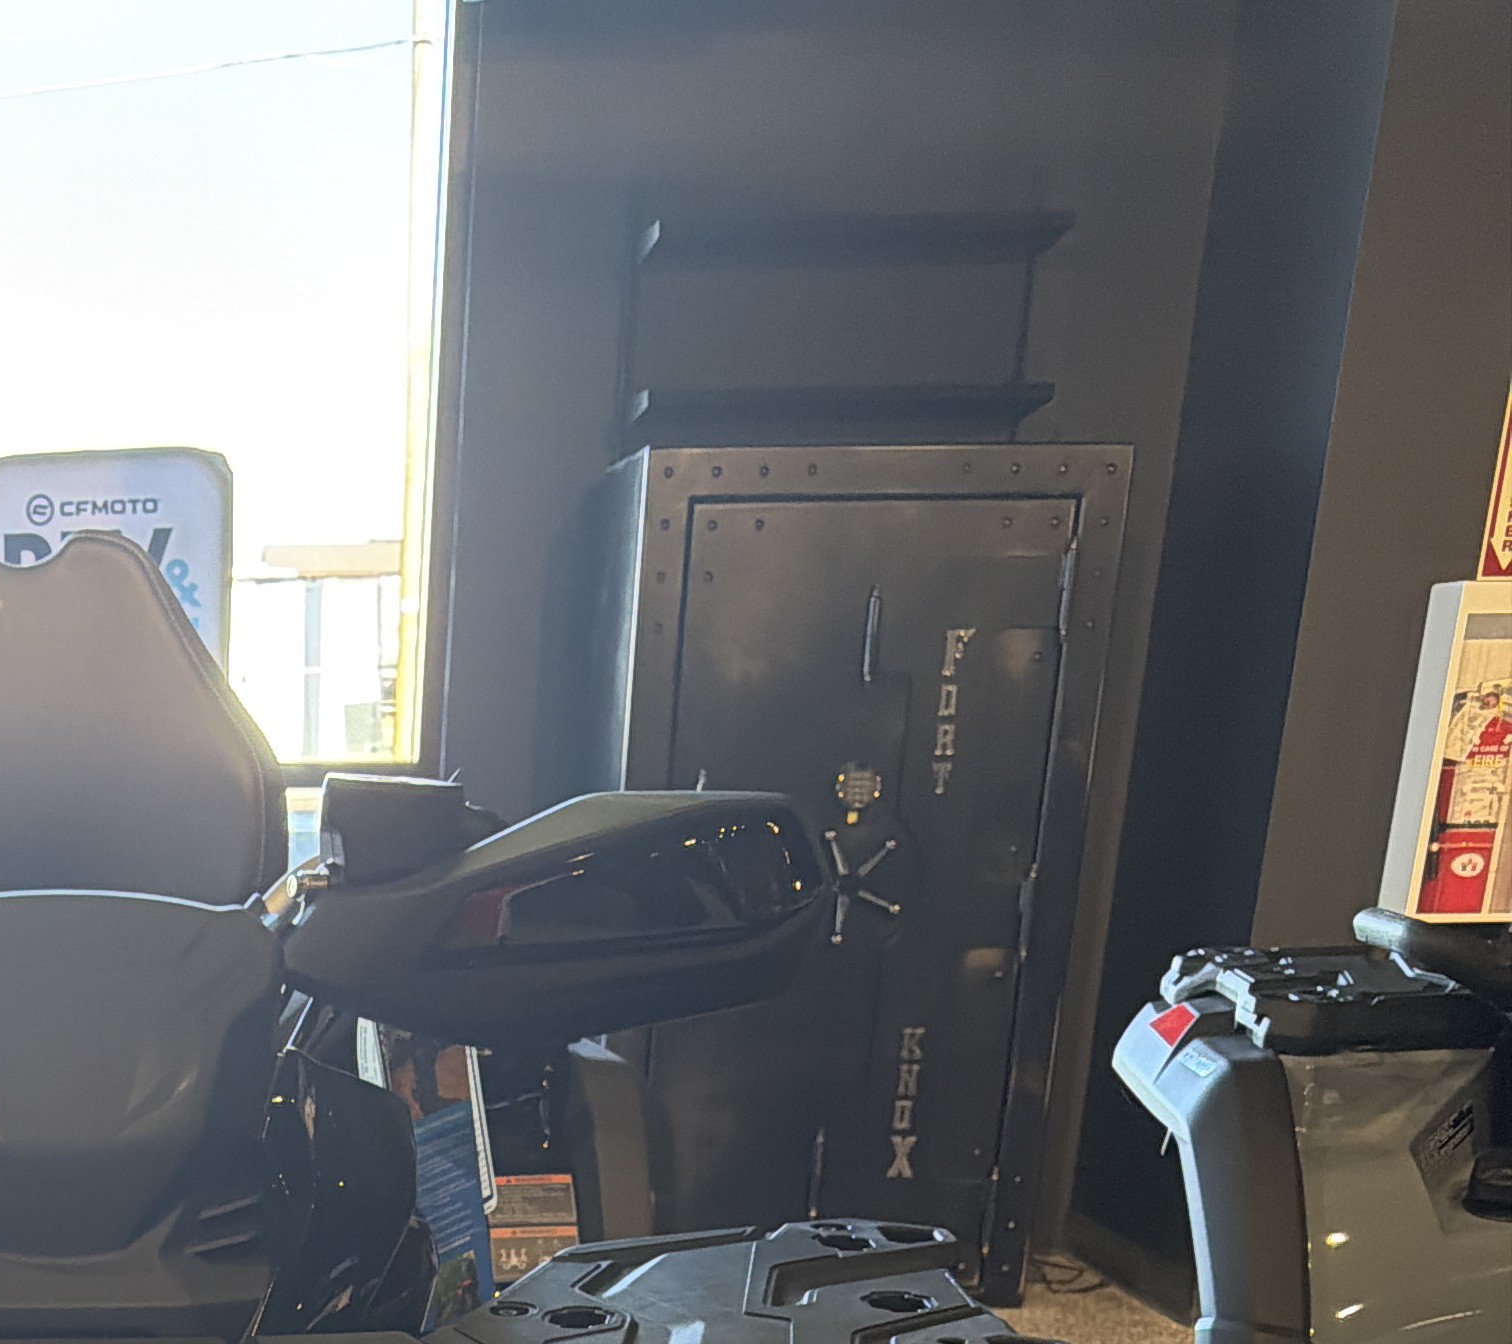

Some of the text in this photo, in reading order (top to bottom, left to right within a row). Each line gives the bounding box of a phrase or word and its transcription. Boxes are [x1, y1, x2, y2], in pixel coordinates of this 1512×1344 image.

[59, 497, 158, 518] CFMOTO
[931, 627, 976, 795] FORT
[1474, 754, 1506, 769] FIRE
[885, 1026, 927, 1180] KNOX
